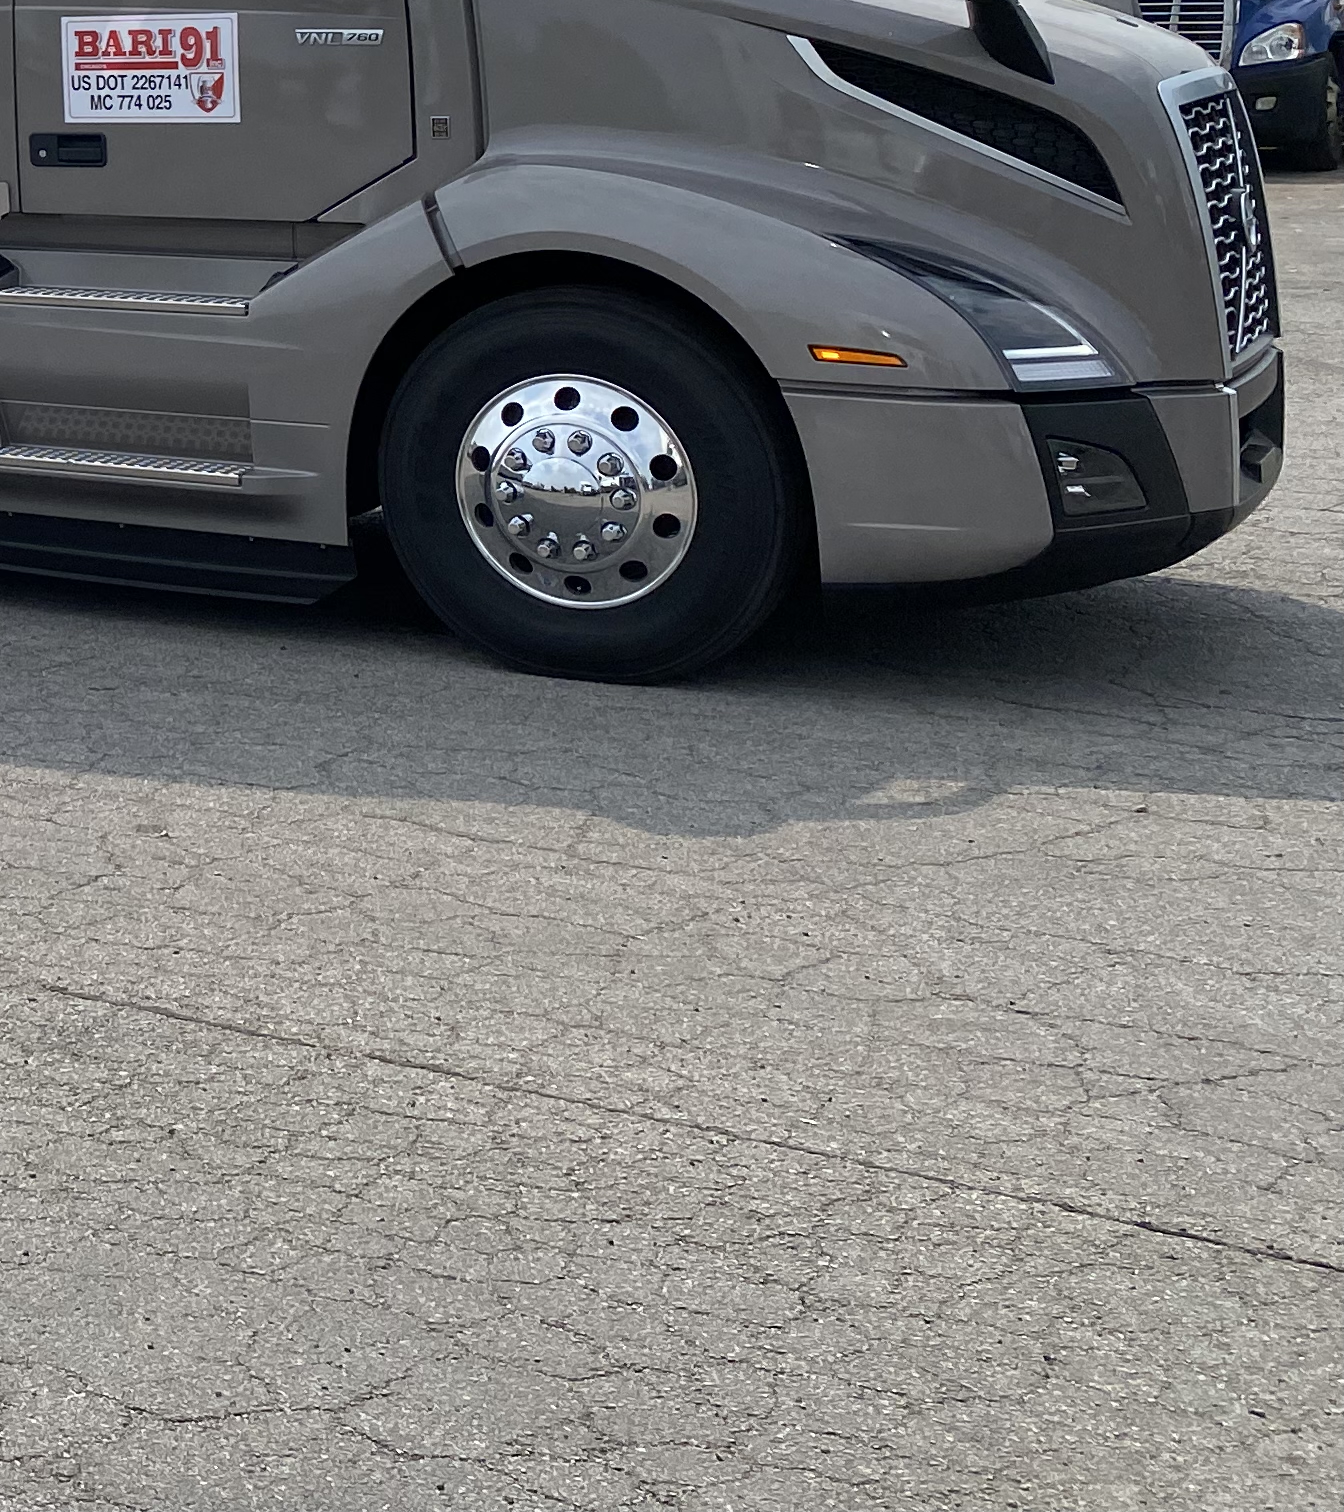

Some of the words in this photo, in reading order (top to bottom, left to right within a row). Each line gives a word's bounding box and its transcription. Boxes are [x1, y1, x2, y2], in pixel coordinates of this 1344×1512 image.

[296, 31, 342, 45] VNL
[346, 32, 380, 42] 760
[74, 28, 176, 59] BARI
[179, 26, 224, 70] 91
[71, 75, 92, 91] US
[96, 74, 128, 91] DOT
[131, 74, 189, 91] 2267141
[90, 94, 113, 111] MC
[117, 94, 143, 111] 774
[146, 94, 173, 111] 025
